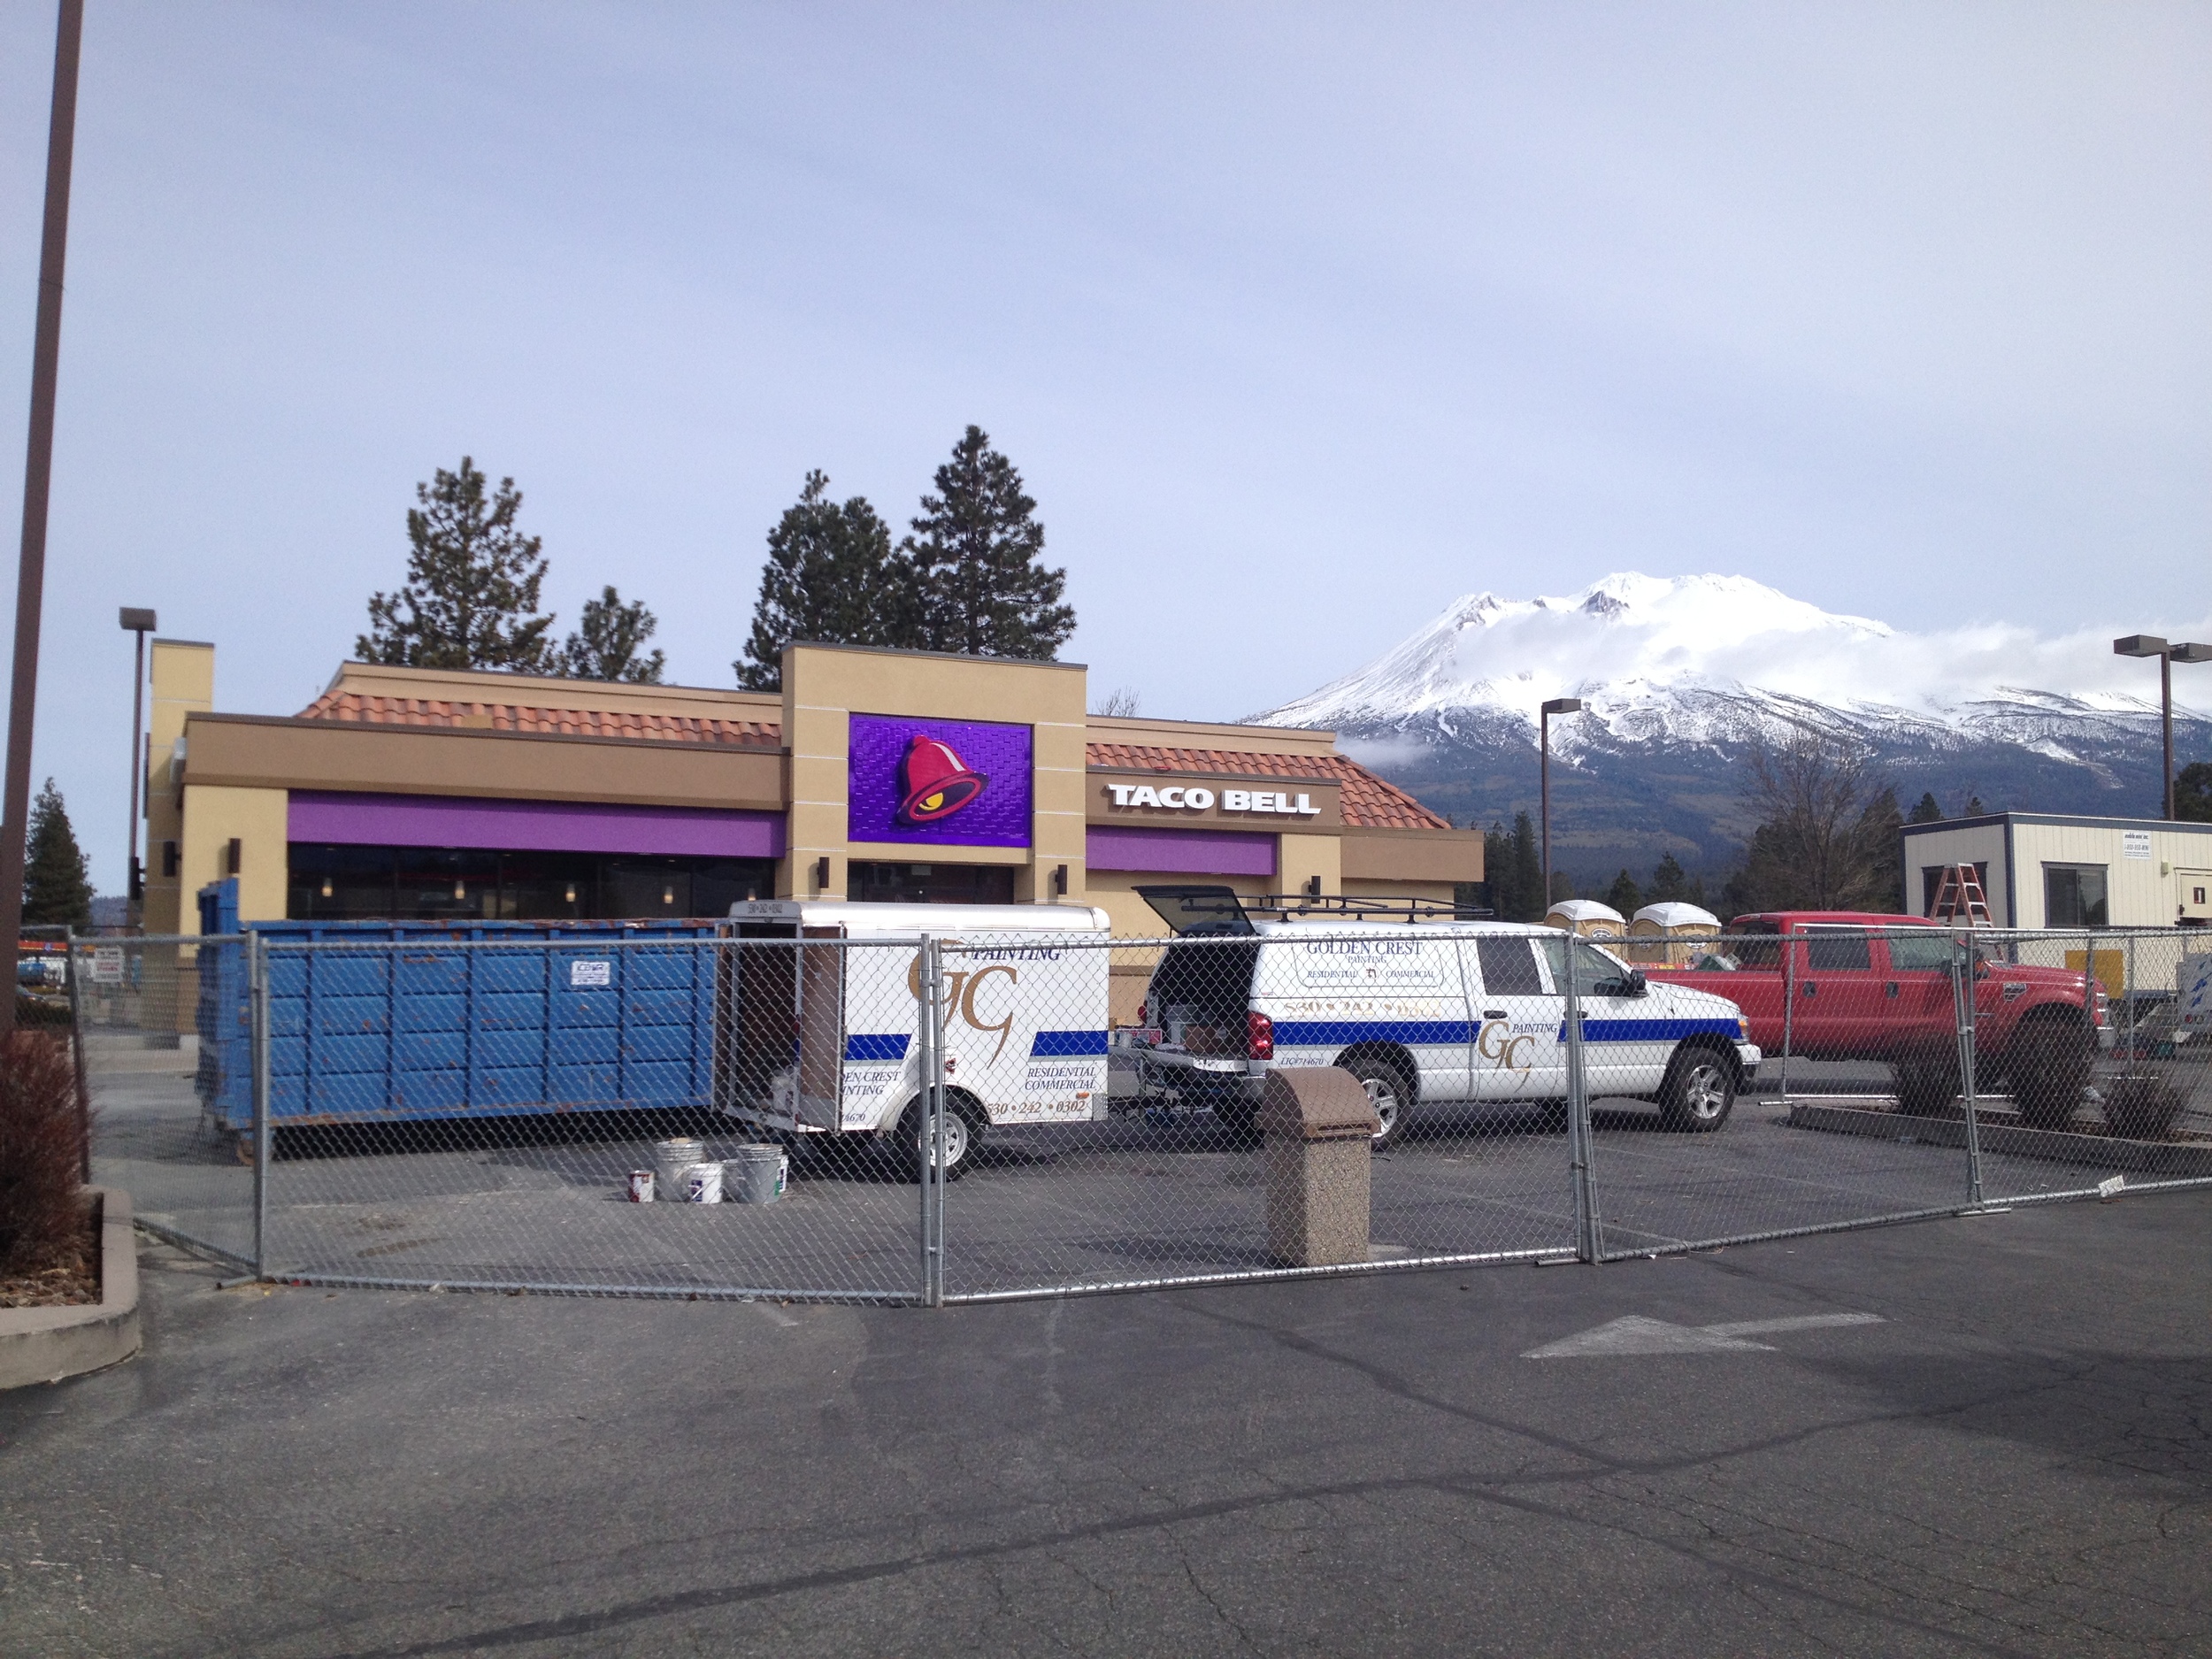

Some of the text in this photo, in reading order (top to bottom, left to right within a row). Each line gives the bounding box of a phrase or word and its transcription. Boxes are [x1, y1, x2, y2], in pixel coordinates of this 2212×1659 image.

[1107, 784, 1322, 815] TACO BELL
[1307, 941, 1423, 955] GOLDEN CREST
[972, 949, 1061, 961] PAINTING
[1512, 1023, 1558, 1033] PAINTING
[863, 1071, 902, 1082] CREST
[1027, 1067, 1096, 1078] RESIDENTIAL
[1025, 1079, 1096, 1090] COMMERCIAL
[1018, 1101, 1042, 1114] 242
[1056, 1100, 1087, 1113] 0302
